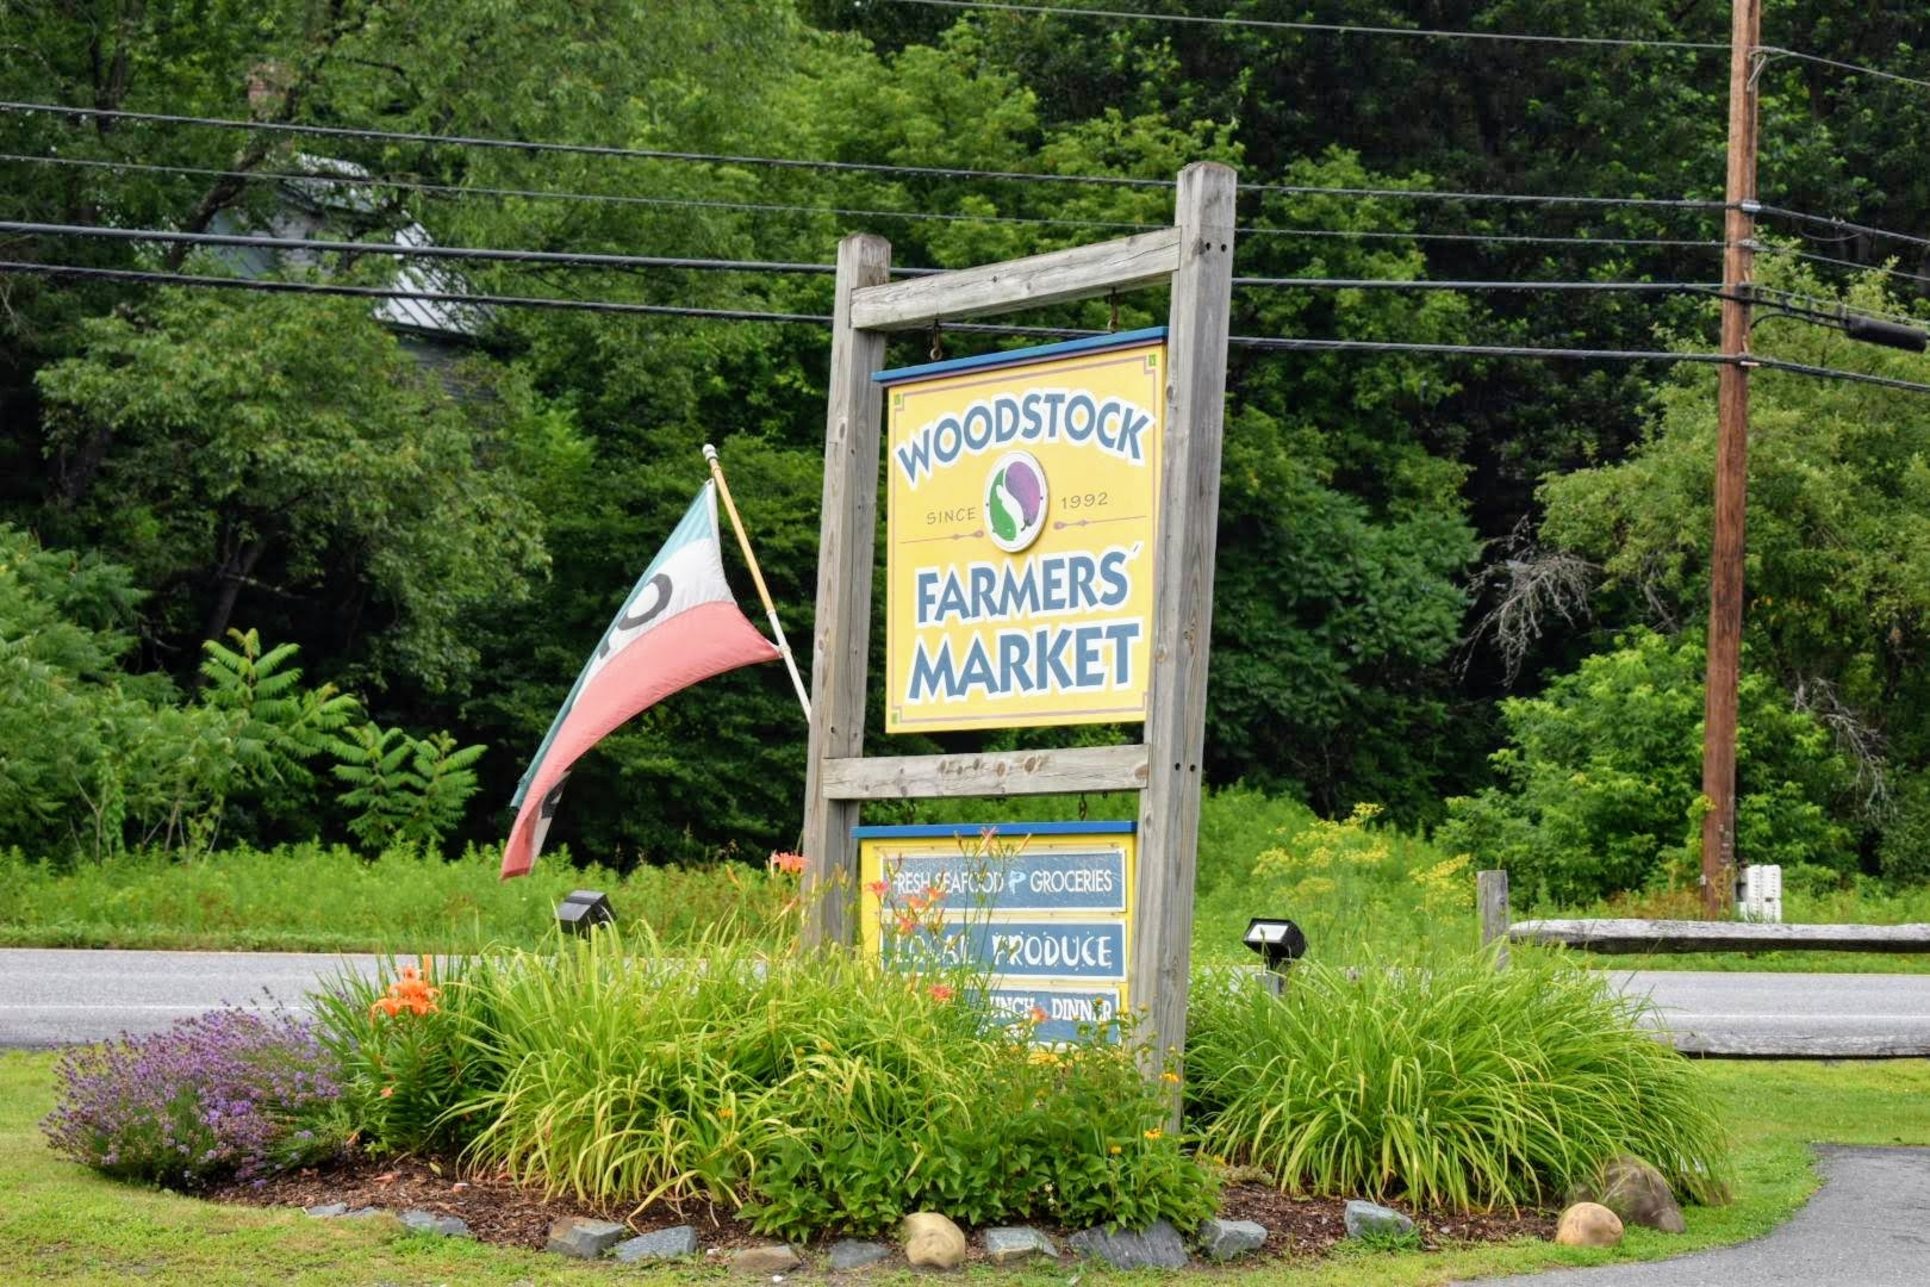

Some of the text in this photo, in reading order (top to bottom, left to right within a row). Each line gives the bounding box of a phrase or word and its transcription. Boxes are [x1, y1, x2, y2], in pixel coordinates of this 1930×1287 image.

[896, 392, 1150, 485] WOODSTOCK
[926, 491, 1109, 525] SINCE 1992
[908, 622, 1140, 700] MARKET
[1030, 869, 1113, 893] GROCERIES
[895, 932, 1113, 968] LOAL PRODUCE
[983, 996, 1112, 1021] UNCH DINNR
